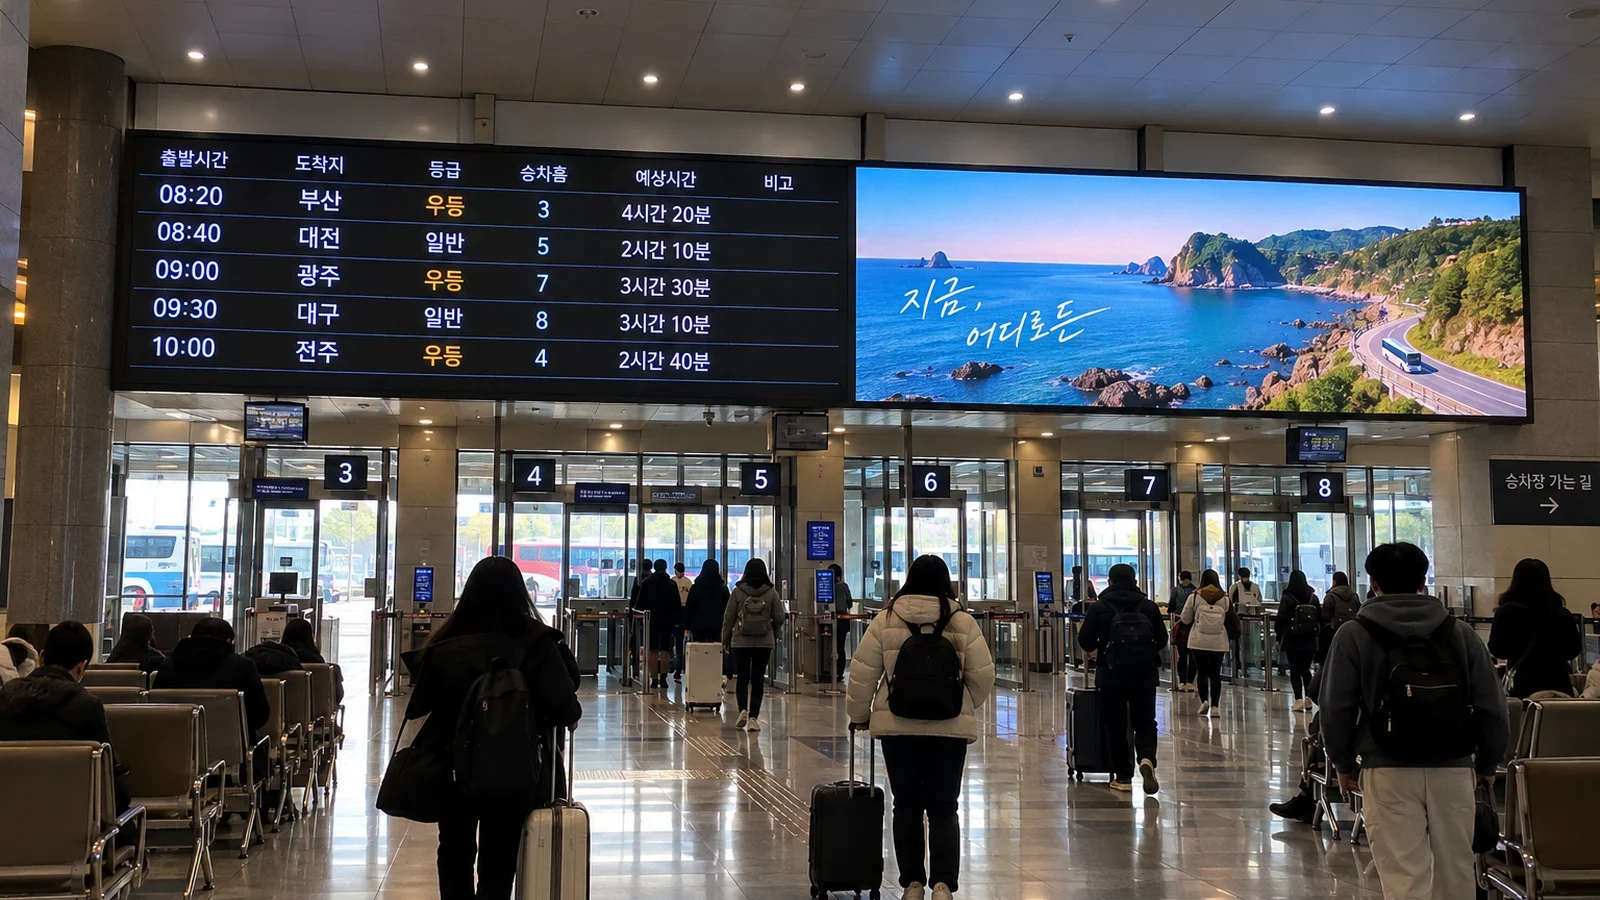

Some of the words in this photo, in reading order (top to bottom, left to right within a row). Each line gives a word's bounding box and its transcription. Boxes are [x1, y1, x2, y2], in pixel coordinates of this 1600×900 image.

[161, 149, 228, 168] 출발시간
[296, 155, 343, 174] 도착지
[429, 161, 461, 178] 등급
[636, 170, 696, 188] 예상시간
[765, 175, 793, 191] 비고
[160, 184, 222, 205] 08:20
[299, 189, 342, 211] 부산
[426, 195, 464, 216] 우등
[538, 200, 549, 218] 3
[622, 204, 667, 223] 4시간
[673, 206, 711, 224] 20분
[158, 222, 220, 242] 08:40
[300, 227, 339, 249] 대전
[426, 232, 464, 253] 일반
[538, 237, 549, 255] 5
[622, 241, 666, 259] 2시간
[673, 242, 710, 261] 10분
[156, 259, 218, 280] 09:00
[298, 265, 340, 287] 광주
[425, 270, 463, 291] 우등
[537, 275, 548, 292] 7
[621, 277, 666, 296] 3시간
[672, 279, 710, 297] 30분
[900, 276, 982, 320] 지금,
[154, 298, 217, 319] 09:30
[298, 303, 339, 325] 대구
[425, 307, 463, 328] 일반
[536, 311, 548, 329] 8
[620, 314, 665, 333] 3시간
[672, 316, 710, 334] 10분
[966, 299, 1111, 349] 어디로든
[153, 336, 215, 357] 10:00
[296, 341, 338, 363] 전주
[423, 345, 462, 367] 우등
[535, 349, 547, 367] 4
[620, 351, 664, 370] 2시간
[670, 353, 710, 371] 40분
[339, 463, 352, 483] 3
[527, 466, 541, 485] 4
[755, 470, 767, 488] 5
[925, 473, 937, 491] 6
[1144, 476, 1155, 494] 7
[1319, 479, 1331, 497] 8
[1506, 474, 1544, 489] 승차장
[1550, 474, 1575, 489] 가는
[1580, 475, 1591, 490] 길
